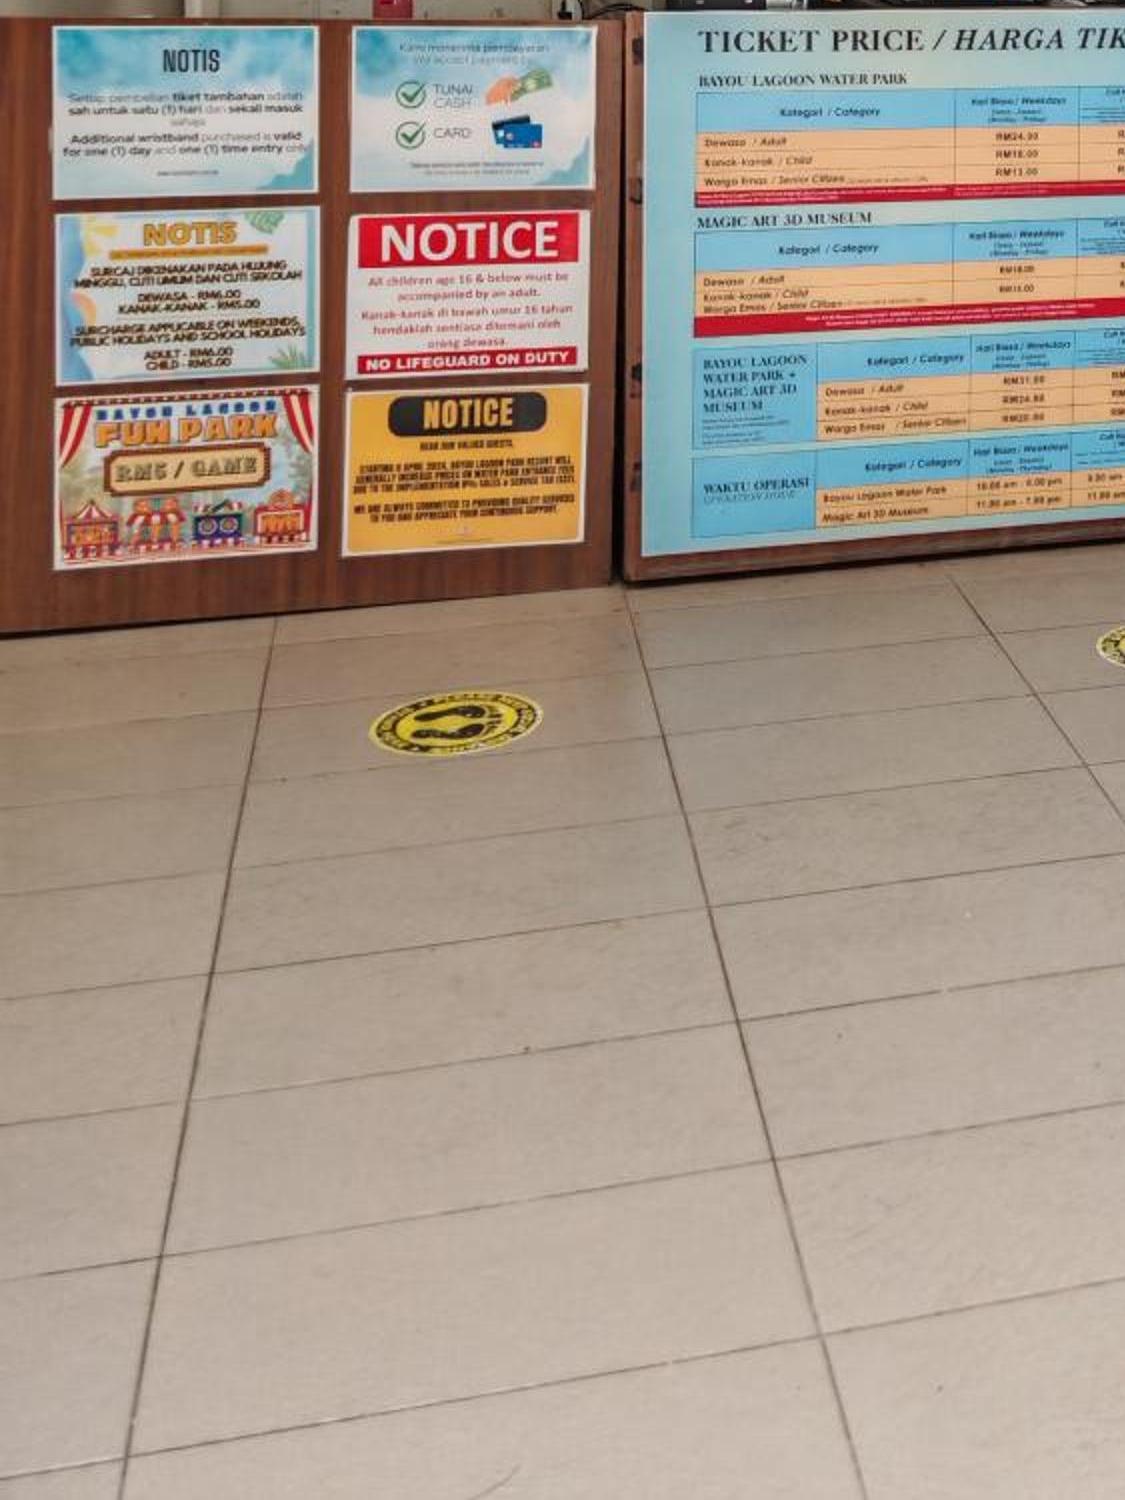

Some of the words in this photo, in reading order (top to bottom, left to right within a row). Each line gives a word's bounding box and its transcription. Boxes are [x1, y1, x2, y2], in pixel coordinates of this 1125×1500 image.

[698, 30, 820, 53] TICKET
[833, 29, 924, 51] PRICE
[933, 29, 947, 49] /
[955, 28, 1064, 51] HARGA
[164, 49, 220, 73] NOTIS
[699, 75, 746, 87] BAYOU
[752, 75, 815, 86] LAGOON
[819, 74, 869, 85] WATER
[872, 73, 907, 84] PARK
[173, 92, 200, 101] tiket
[203, 92, 264, 101] tambahan
[434, 85, 472, 94] TUNAI
[93, 107, 128, 115] untuk
[229, 104, 262, 113] sekali
[265, 104, 302, 113] masuk
[433, 99, 472, 108] CASH
[781, 108, 823, 118] Kategori
[834, 107, 880, 117] Category
[71, 134, 134, 143] Additional
[138, 133, 199, 142] wristband
[274, 132, 301, 141] valid
[434, 128, 470, 138] CARD
[130, 146, 150, 156] day
[222, 144, 247, 153] time
[252, 144, 282, 155] entry
[697, 217, 747, 228] MAGIC
[752, 215, 777, 226] ART
[784, 215, 802, 225] 3D
[808, 213, 872, 224] MUSEUM
[144, 222, 237, 246] NOTIS
[381, 221, 558, 261] NOTICE
[386, 276, 432, 286] children
[459, 275, 472, 284] 16
[488, 273, 523, 282] below
[526, 273, 552, 282] must
[556, 273, 568, 281] be
[398, 290, 473, 302] accompanied
[475, 290, 489, 299] by
[509, 288, 541, 298] adult.
[366, 359, 391, 371] NO
[396, 355, 490, 370] LIFEGUARD
[496, 354, 519, 365] ON
[525, 352, 569, 363] DUTY
[97, 405, 173, 420] BAYOU
[186, 400, 276, 416] LAGOON
[423, 398, 513, 429] NOTICE
[96, 422, 170, 447] FUN
[179, 415, 279, 442] PARK
[704, 483, 750, 494] WAKTU
[754, 478, 809, 491] OPERASI
